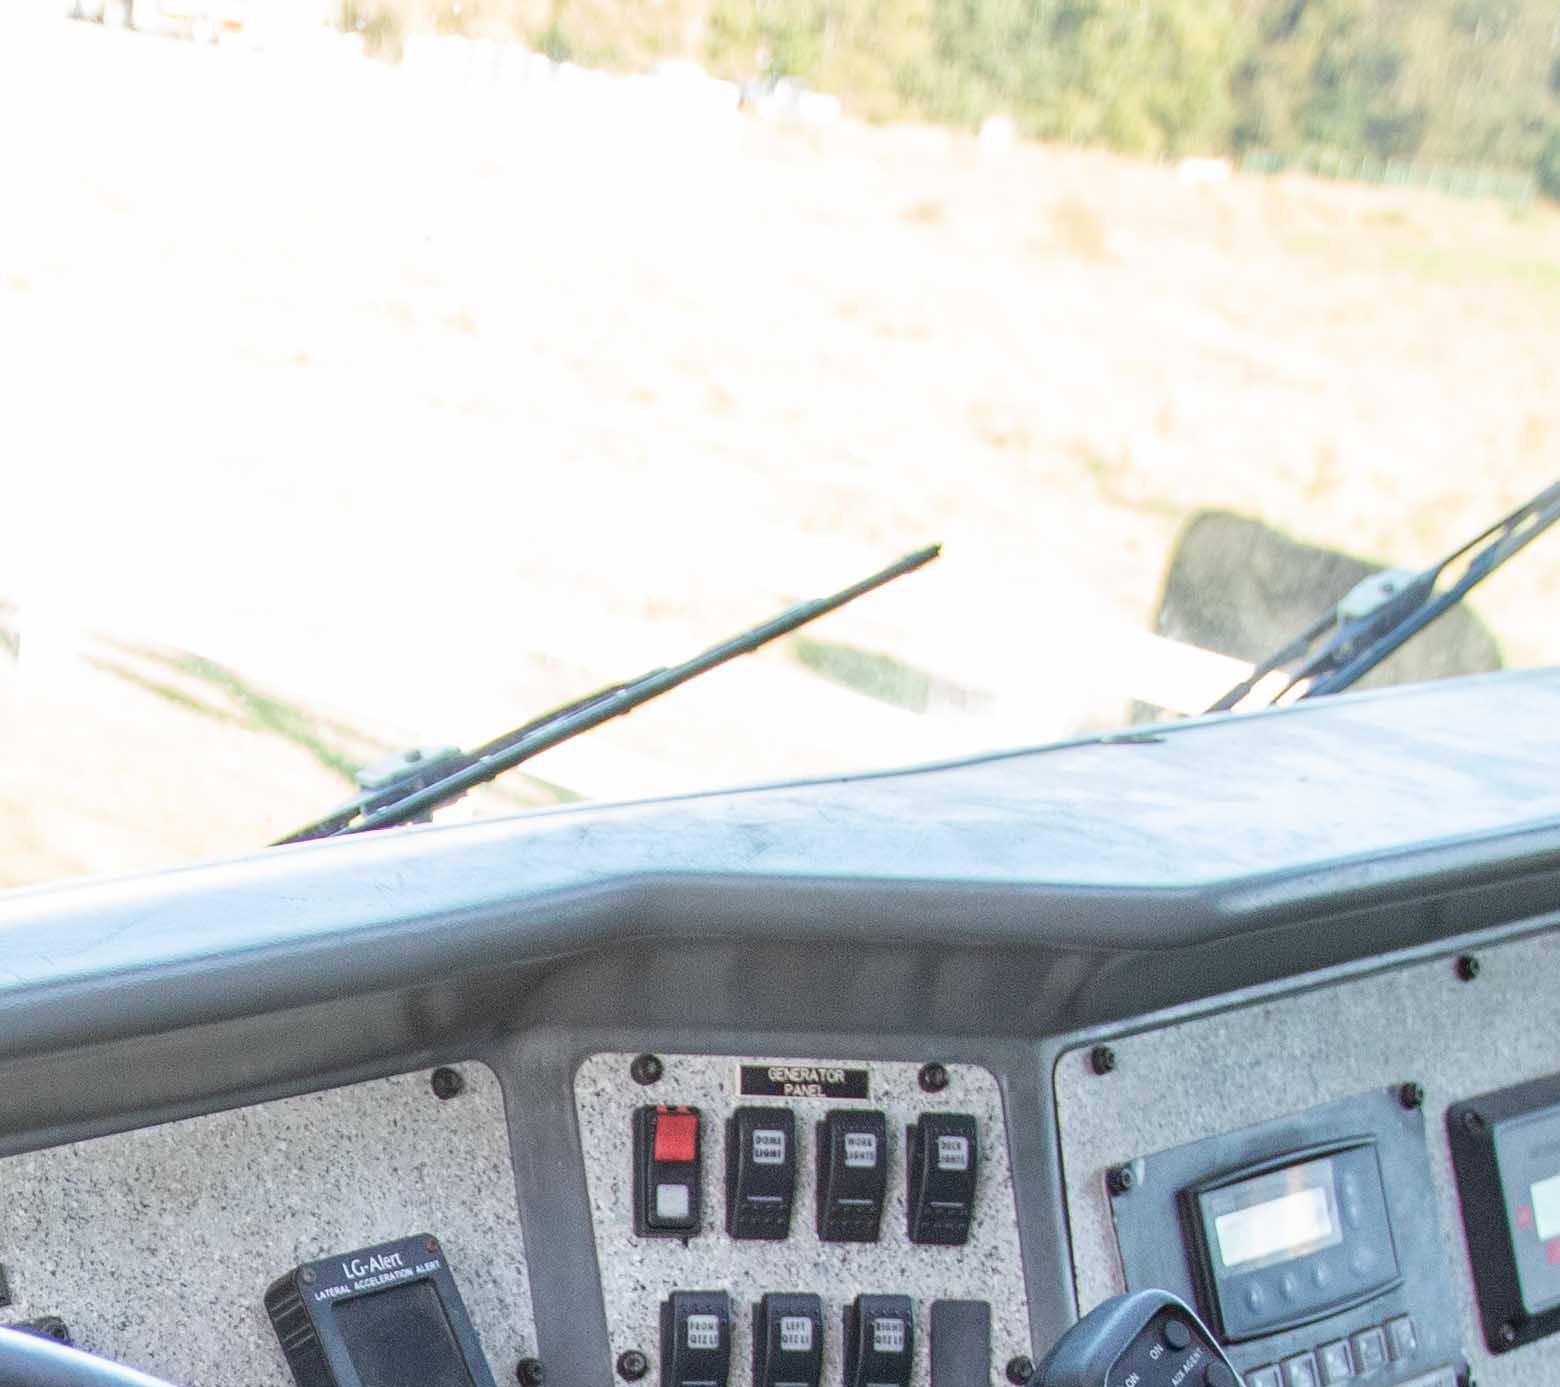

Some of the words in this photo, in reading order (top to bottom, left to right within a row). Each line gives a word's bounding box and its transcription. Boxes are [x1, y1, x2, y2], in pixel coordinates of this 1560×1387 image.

[768, 1067, 847, 1083] GENERATOR
[783, 1083, 826, 1097] PANEL
[342, 1252, 403, 1280] LG-Alert
[315, 1284, 351, 1301] LATERAL
[353, 1267, 413, 1291] ACCELERATION
[416, 1259, 442, 1273] ALERT
[1149, 1343, 1164, 1360] ON
